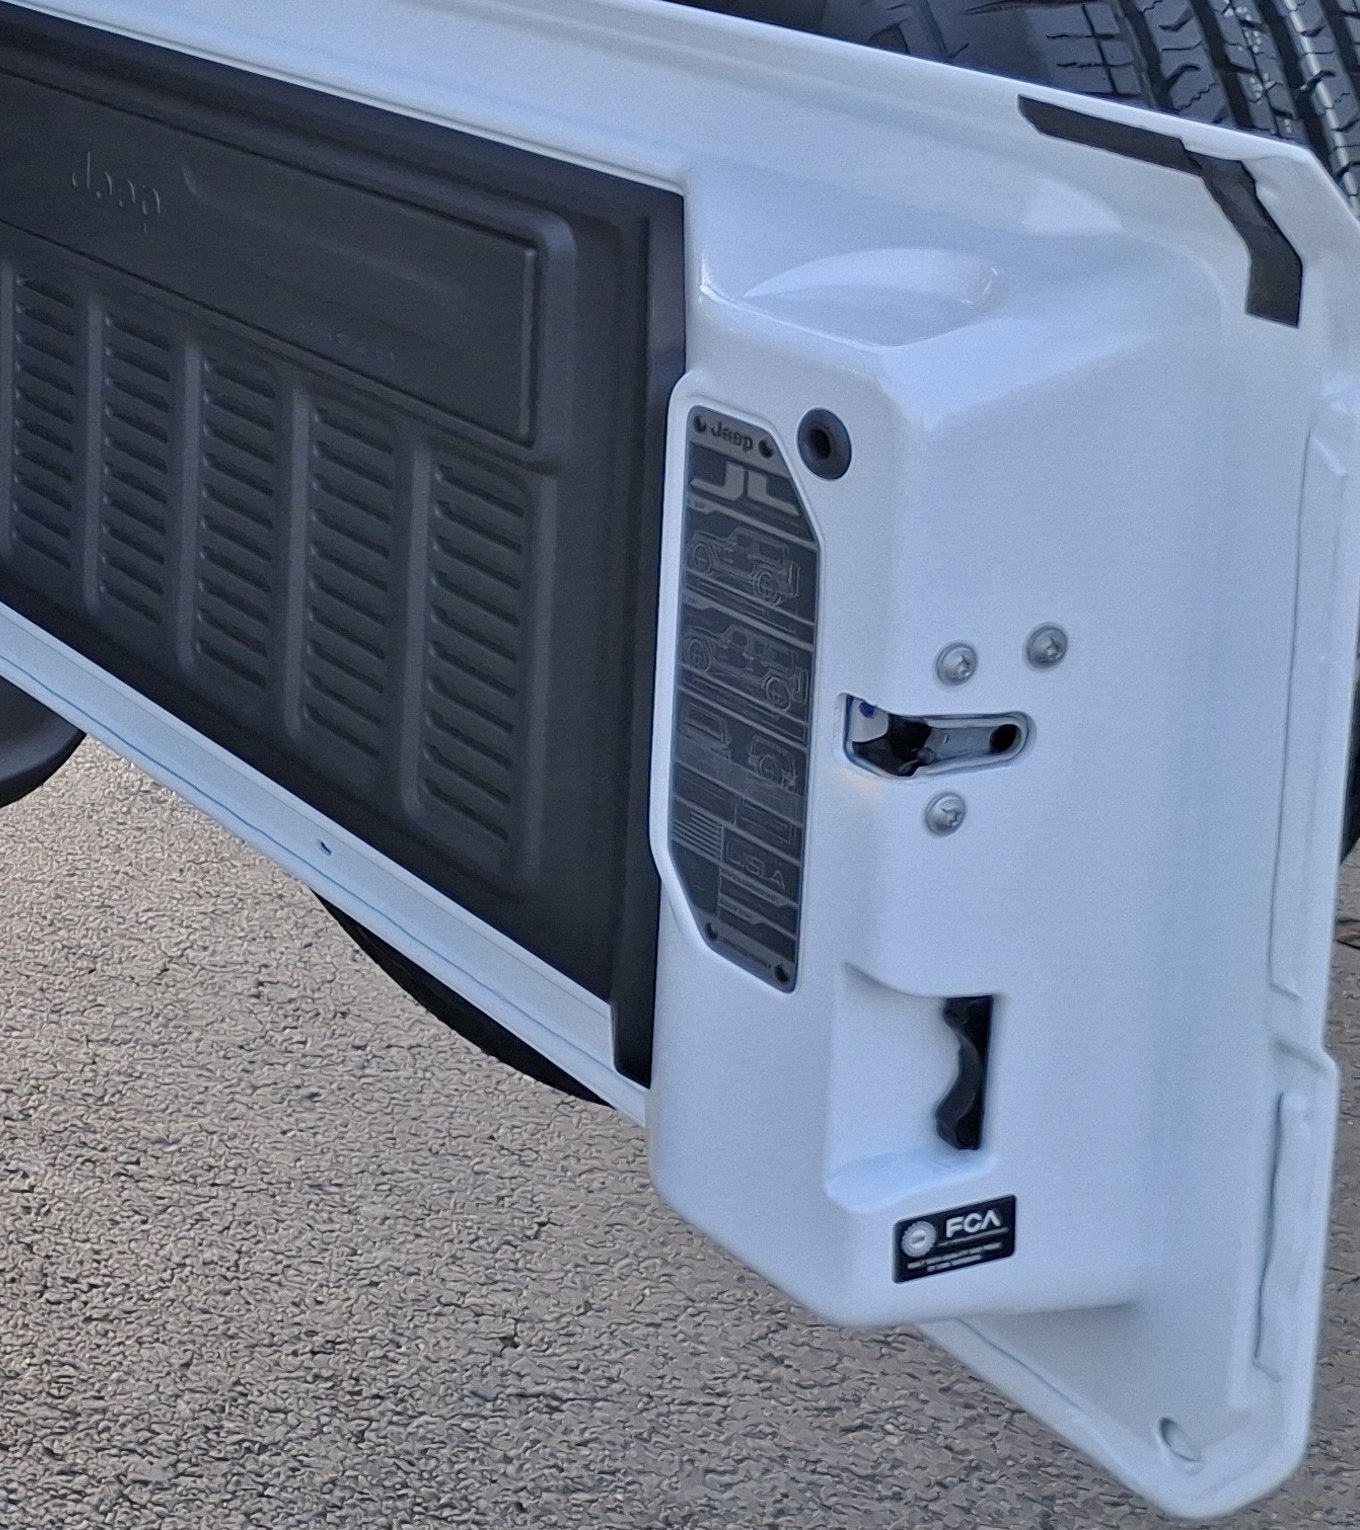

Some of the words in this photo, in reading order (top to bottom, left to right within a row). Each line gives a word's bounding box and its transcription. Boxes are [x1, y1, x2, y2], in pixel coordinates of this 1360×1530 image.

[709, 421, 754, 453] Jeep
[690, 460, 801, 518] JL
[945, 1208, 1002, 1239] FCA
